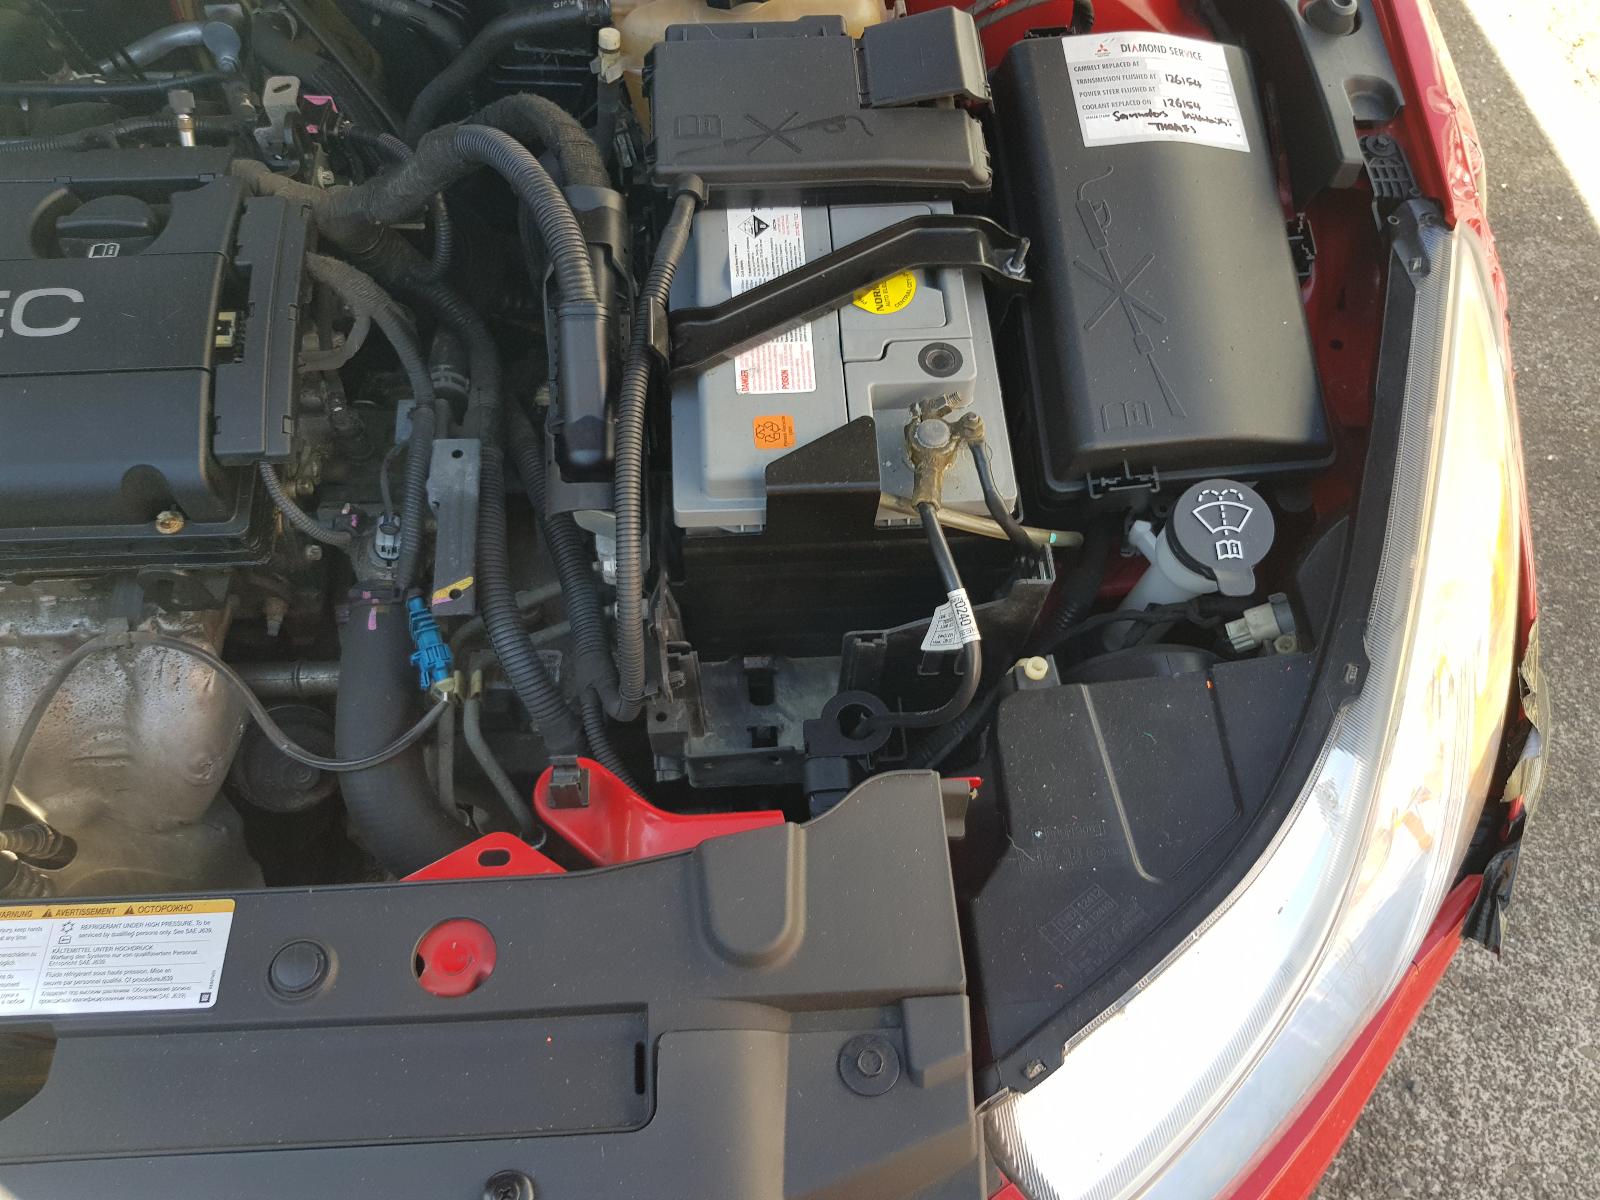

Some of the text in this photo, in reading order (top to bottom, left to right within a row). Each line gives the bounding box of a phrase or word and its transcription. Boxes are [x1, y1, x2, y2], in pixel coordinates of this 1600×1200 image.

[1120, 43, 1202, 60] DIAMOND SERVICE
[1073, 64, 1101, 72] CAMBELT
[1102, 61, 1131, 69] REPLACED
[1076, 75, 1121, 85] TRANSMISSION
[1165, 73, 1202, 89] 126154
[1102, 88, 1120, 96] STEER
[1120, 86, 1148, 94] FLUSHED
[1082, 102, 1110, 110] COOLANT
[1163, 98, 1201, 111] 126154
[741, 369, 750, 392] DANGER
[781, 369, 789, 390] POISON
[56, 907, 117, 917] AVERTISSEMENT
[138, 904, 194, 914] ОСТОРОЖНО
[81, 922, 122, 930] REFRIGERANT
